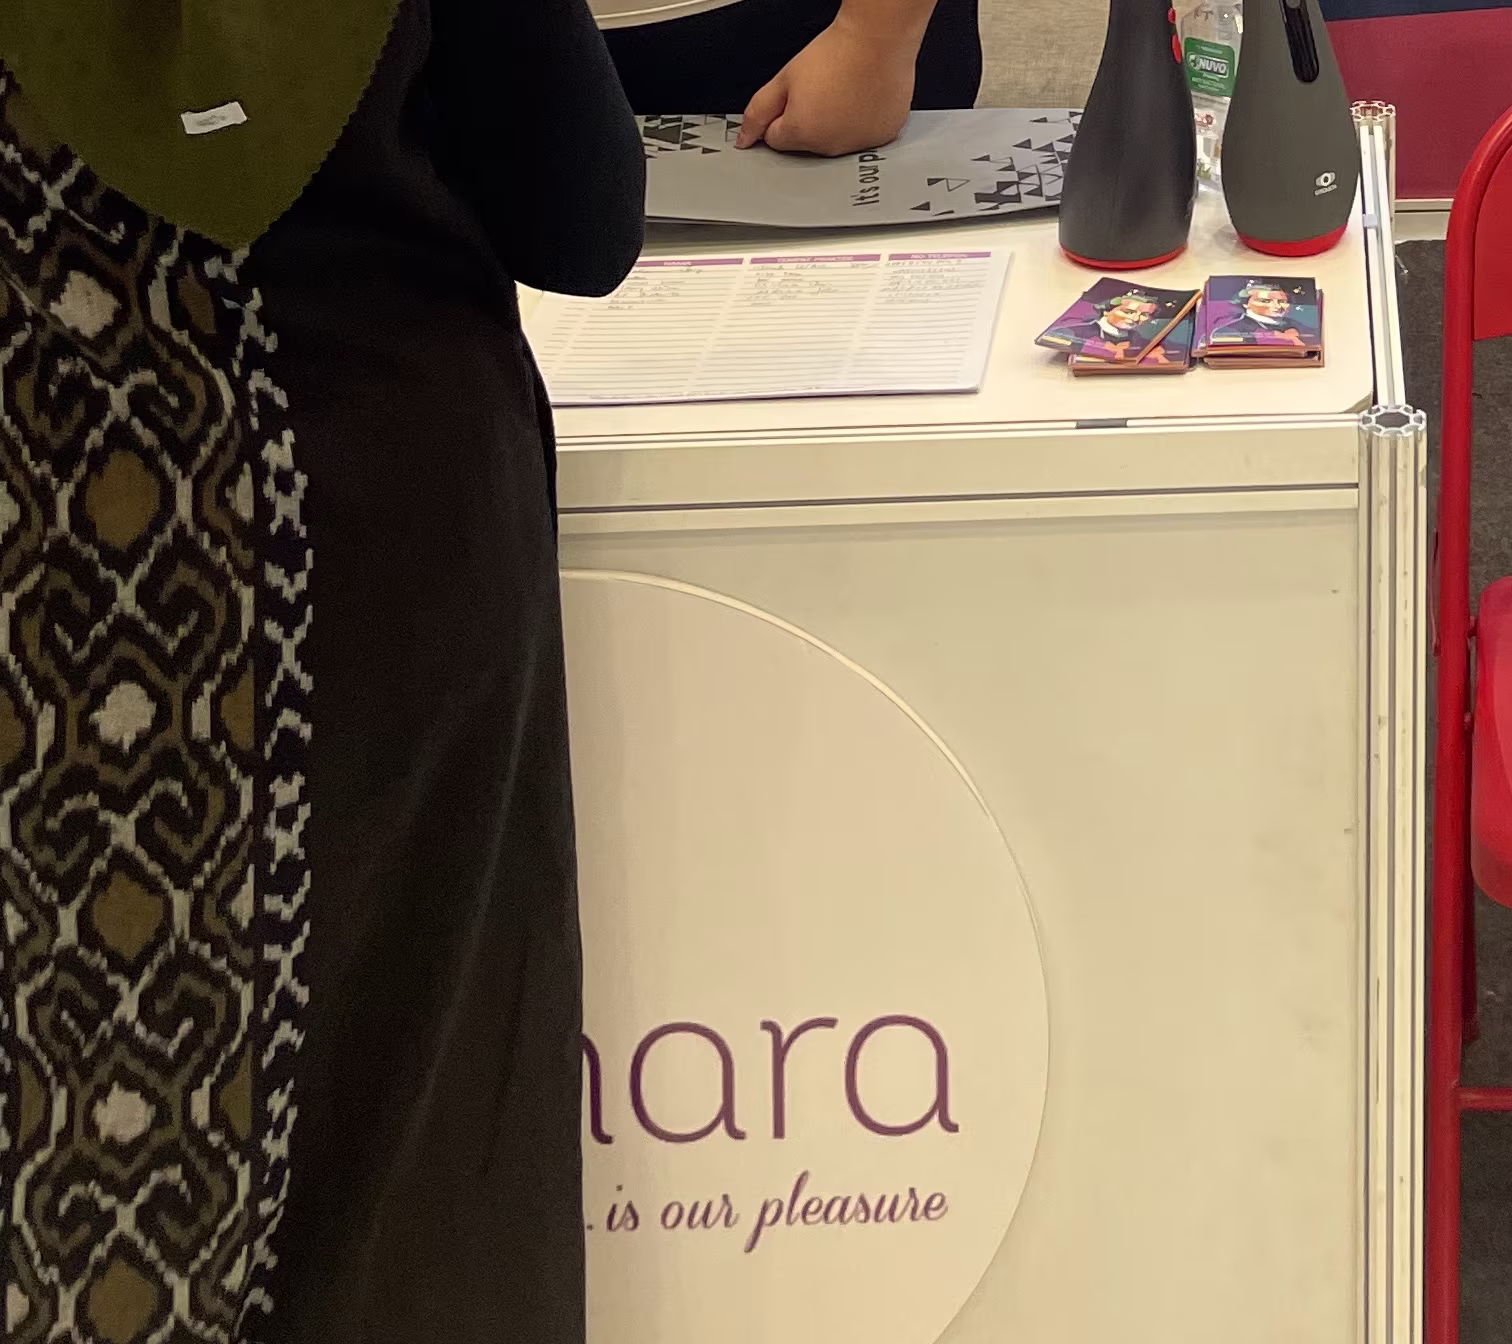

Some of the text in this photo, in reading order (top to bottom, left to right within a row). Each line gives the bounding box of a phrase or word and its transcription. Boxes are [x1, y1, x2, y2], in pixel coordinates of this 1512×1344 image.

[1199, 57, 1228, 74] NUVO
[605, 1169, 950, 1254] is our pleasure
